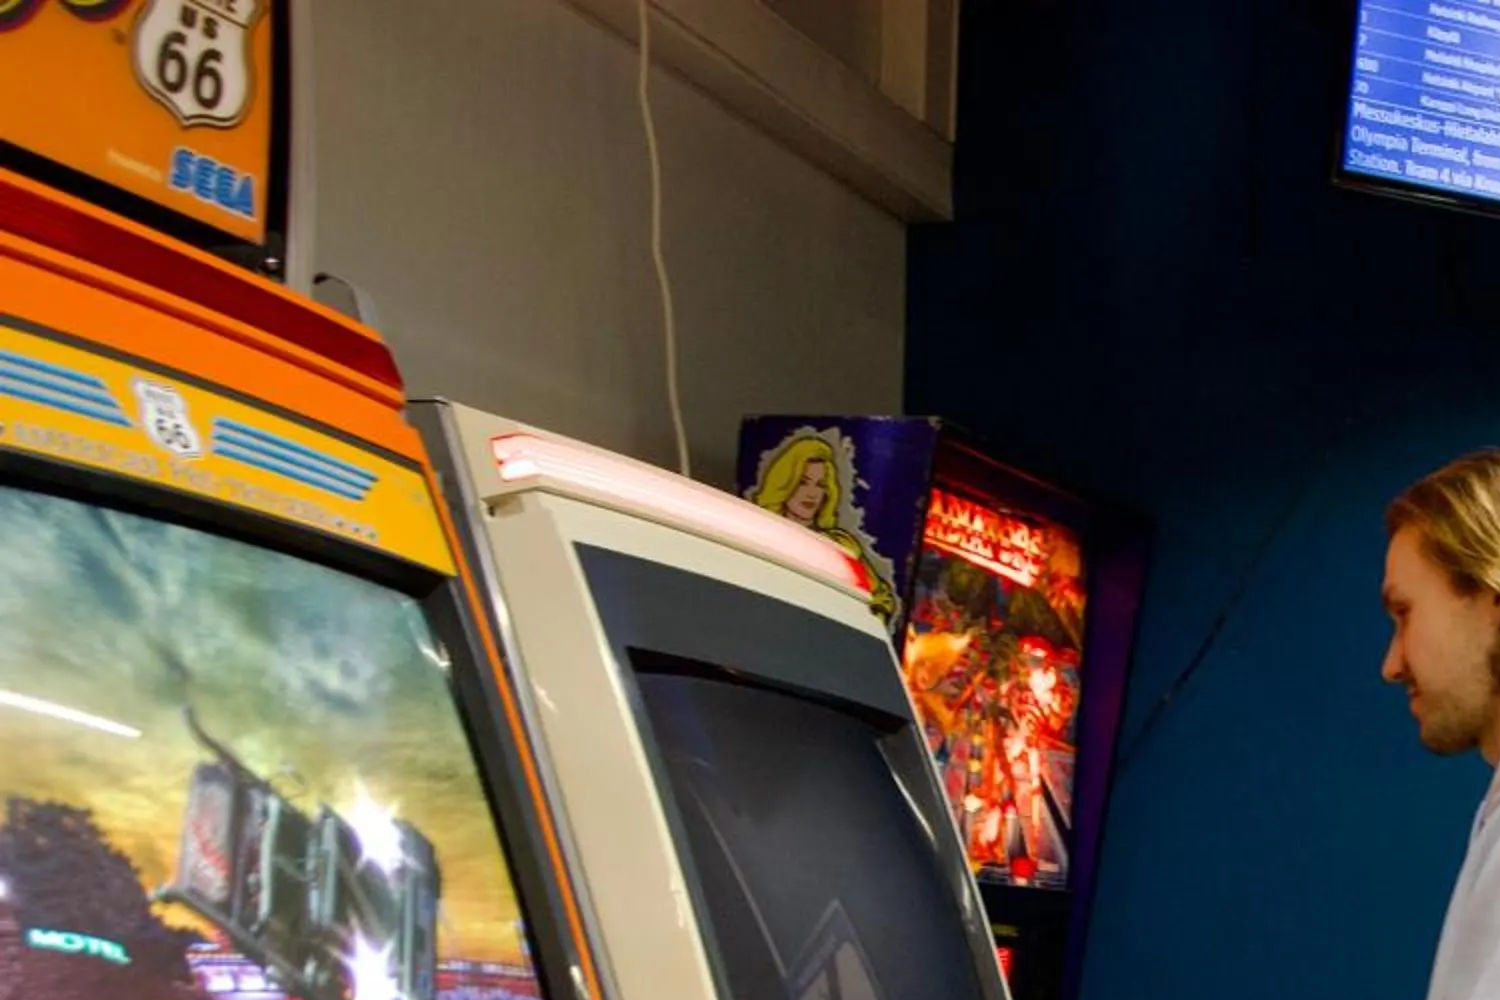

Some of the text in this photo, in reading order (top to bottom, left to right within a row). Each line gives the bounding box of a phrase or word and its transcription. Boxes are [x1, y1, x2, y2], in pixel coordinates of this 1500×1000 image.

[158, 31, 224, 110] 66
[171, 147, 257, 218] SEGA
[27, 927, 131, 965] MOTEL
